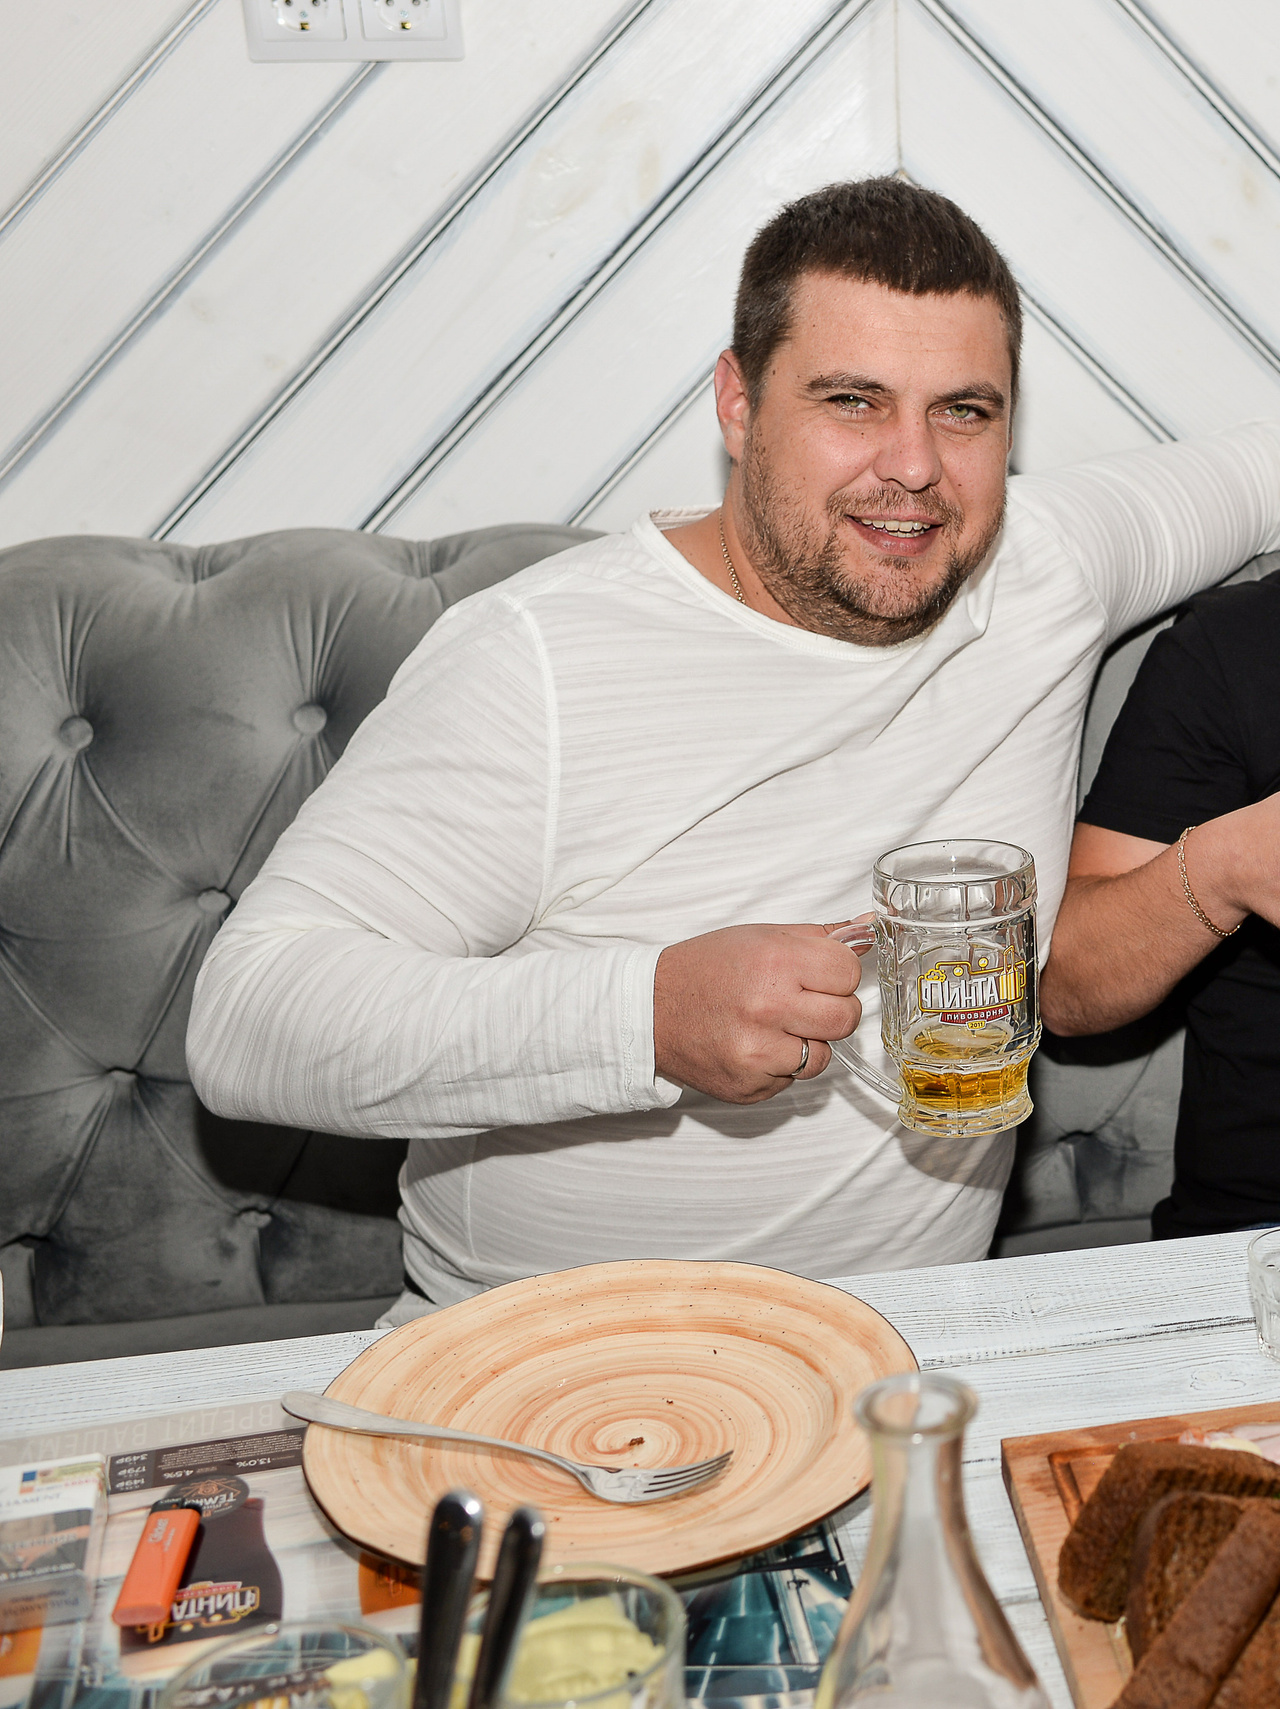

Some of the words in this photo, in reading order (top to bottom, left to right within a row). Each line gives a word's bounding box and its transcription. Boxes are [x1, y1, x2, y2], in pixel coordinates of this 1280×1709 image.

[922, 976, 999, 1009] ПИНТА
[946, 1008, 1004, 1021] пивоварня
[160, 1404, 274, 1442] ВРЕДИТ
[173, 1589, 256, 1621] ПИНТА
